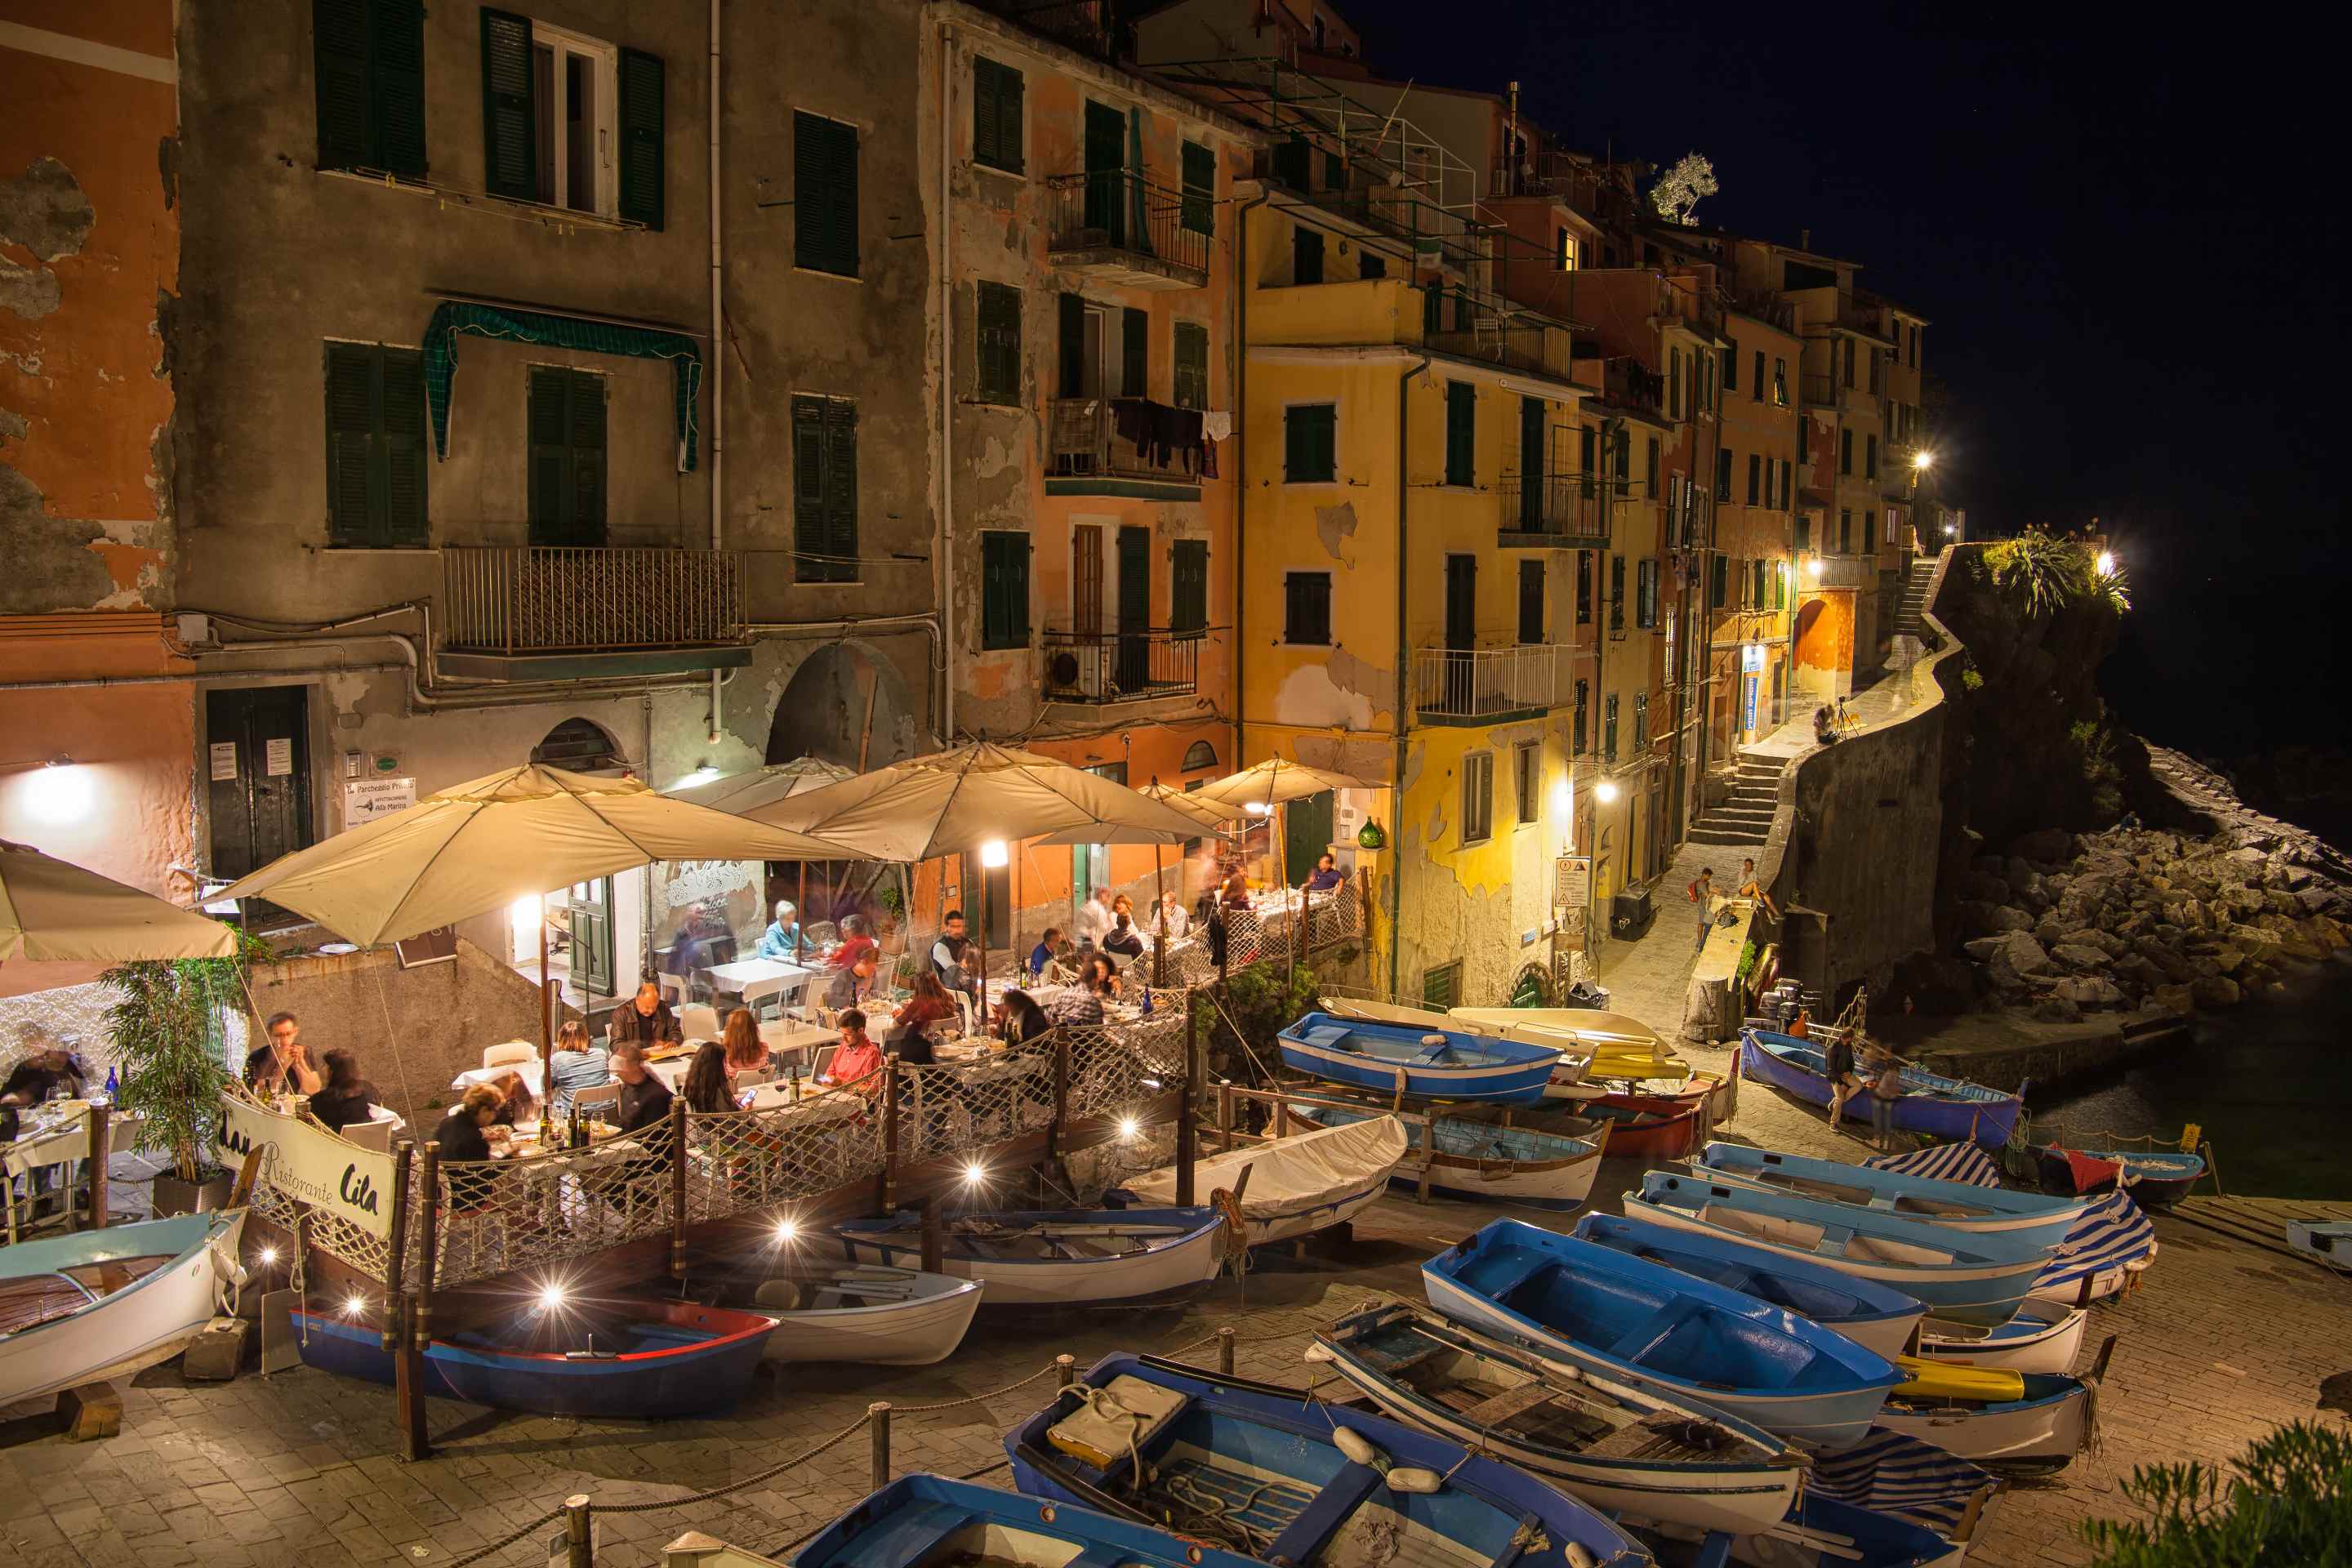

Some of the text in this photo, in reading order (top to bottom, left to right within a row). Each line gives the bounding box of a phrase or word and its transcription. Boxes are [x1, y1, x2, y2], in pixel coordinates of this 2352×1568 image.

[357, 784, 390, 793] Parcheggio
[387, 802, 407, 810] Marina
[259, 1141, 333, 1205] Ristorante
[340, 1163, 378, 1216] Cila
